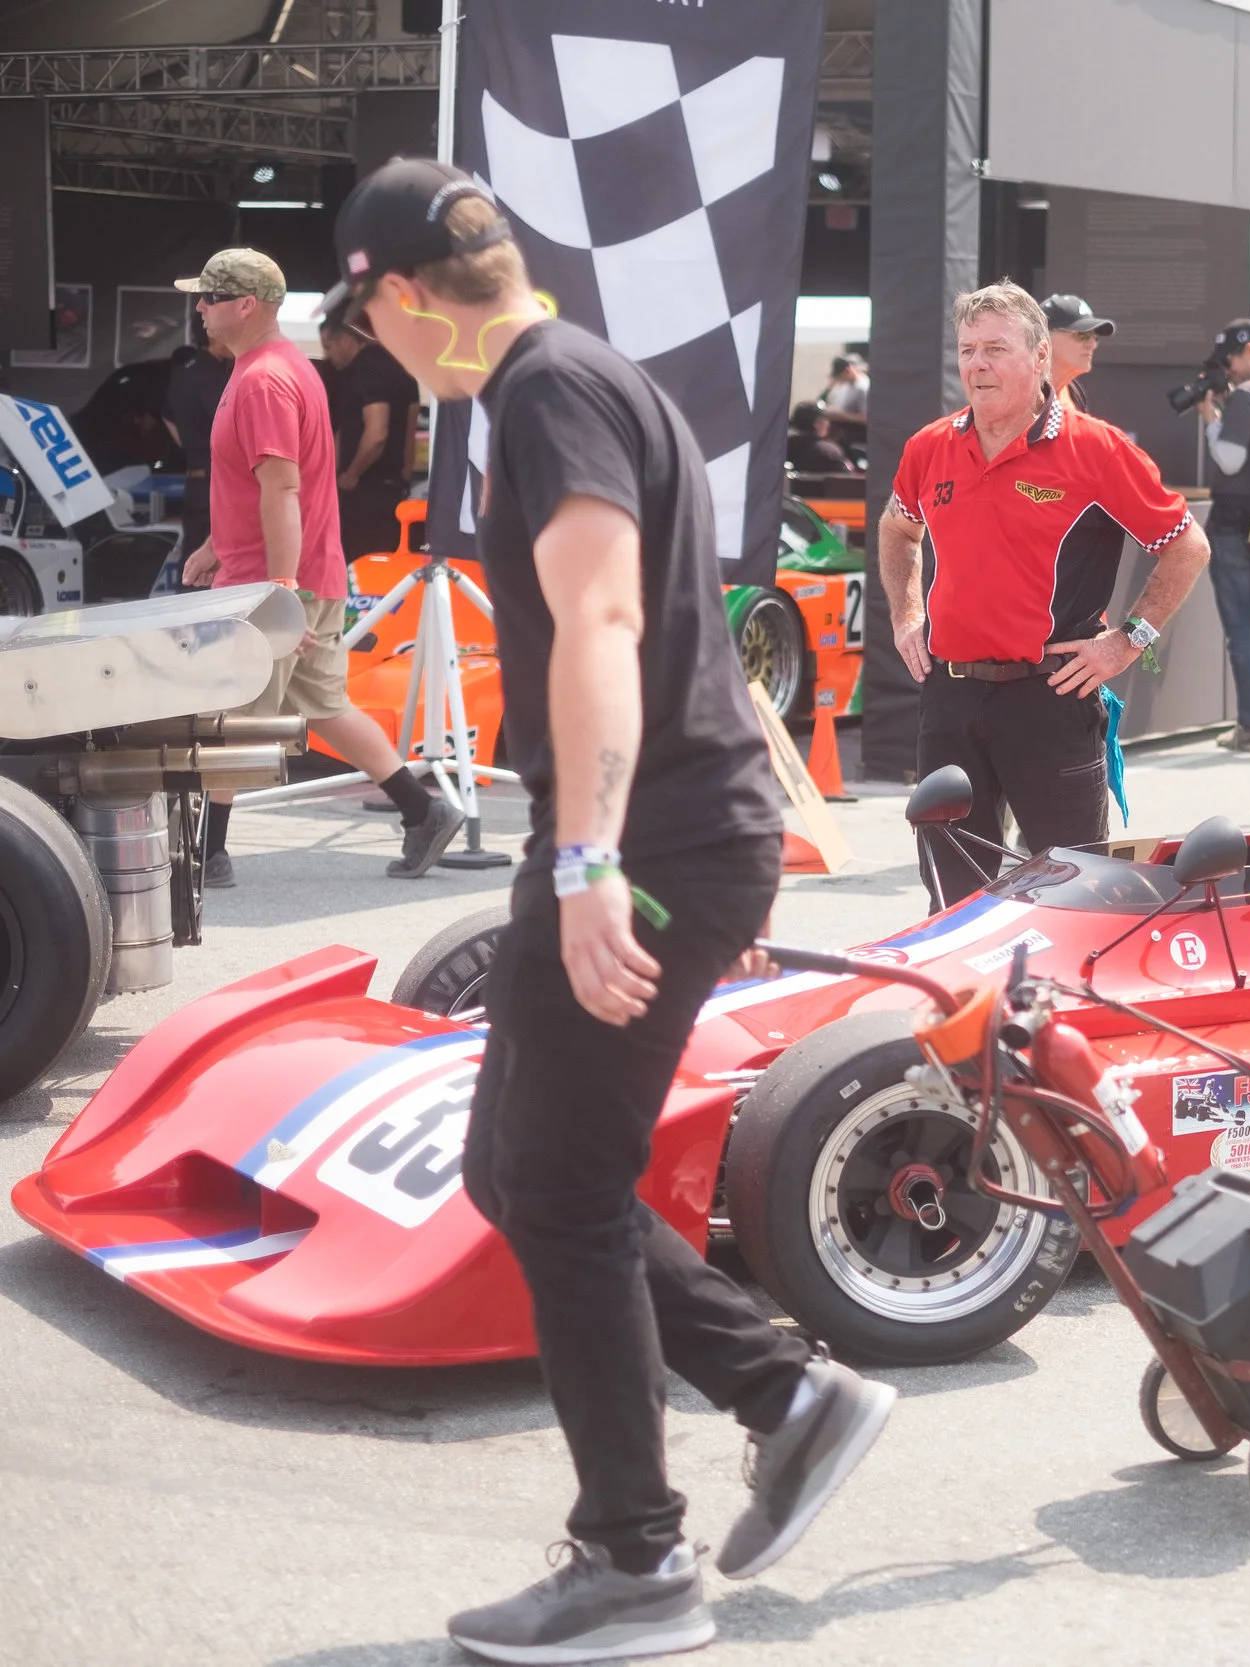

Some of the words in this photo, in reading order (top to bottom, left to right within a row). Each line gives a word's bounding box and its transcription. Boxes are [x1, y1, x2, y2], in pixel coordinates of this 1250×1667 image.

[933, 480, 954, 507] 33
[1016, 482, 1062, 502] CHEVRON
[974, 934, 1045, 969] CHAMPON
[1176, 937, 1203, 966] E
